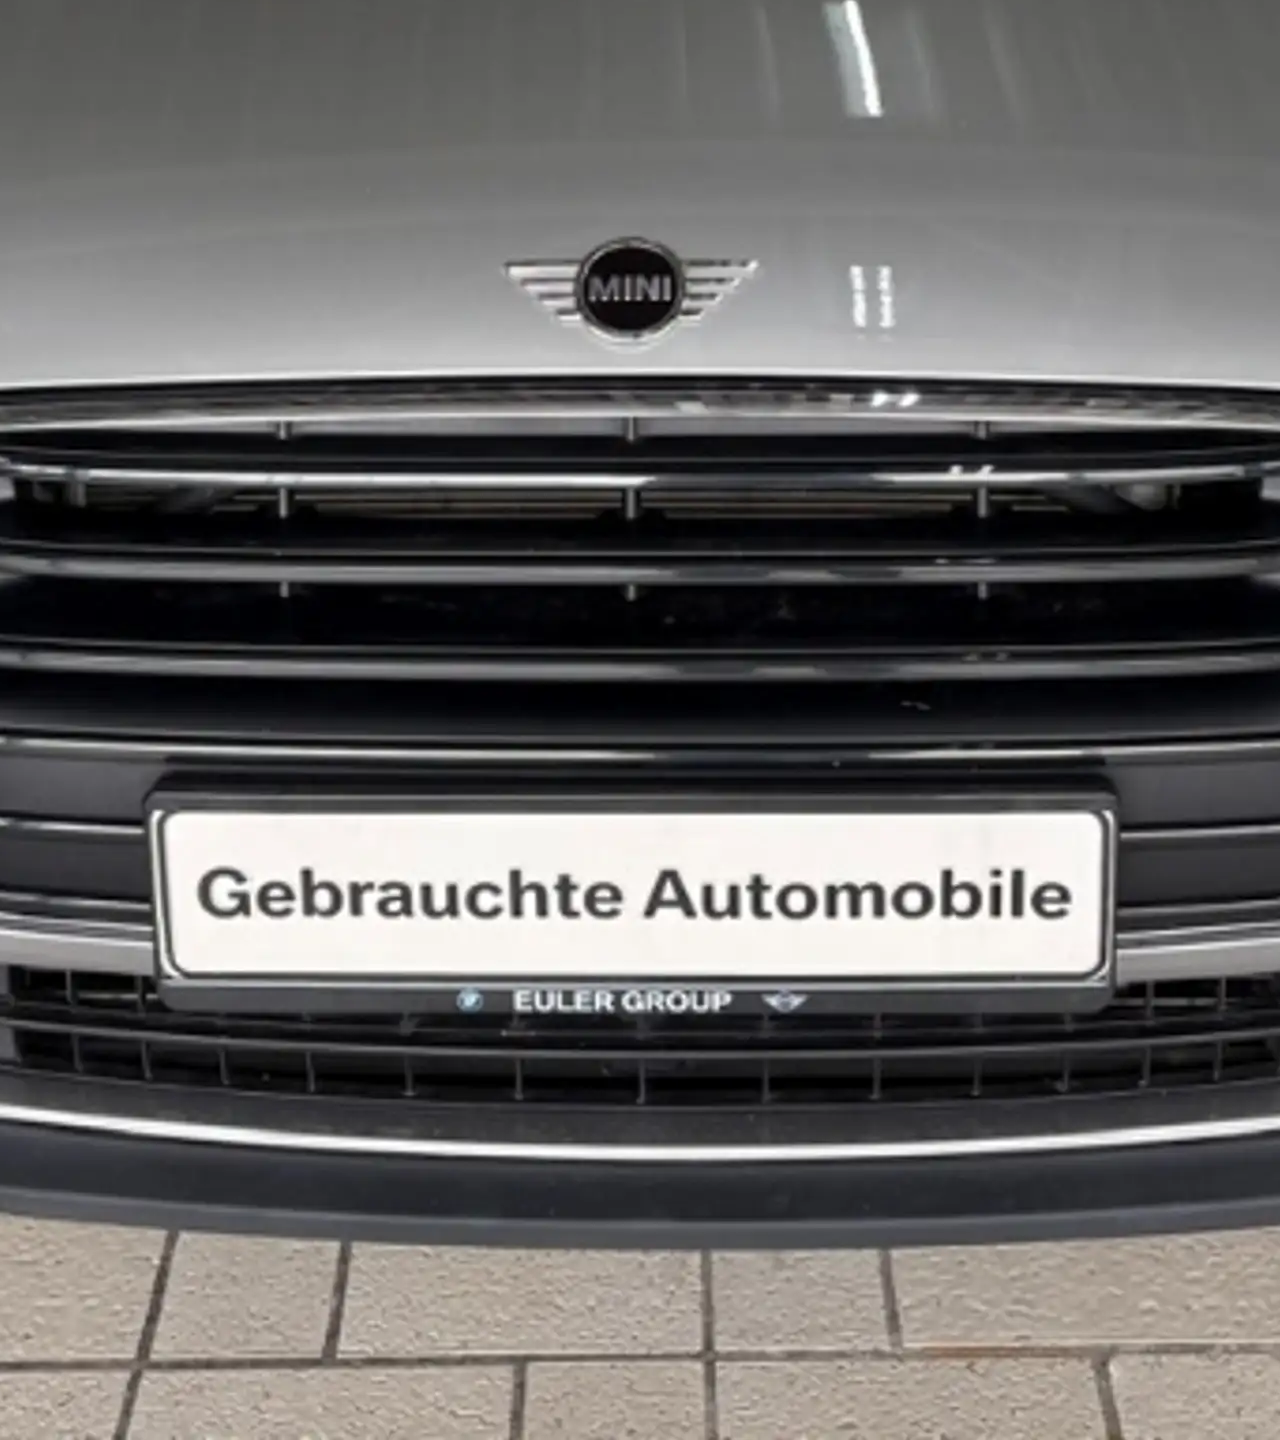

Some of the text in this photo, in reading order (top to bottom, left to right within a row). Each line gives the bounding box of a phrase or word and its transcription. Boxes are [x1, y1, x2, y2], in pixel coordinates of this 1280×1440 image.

[588, 274, 672, 303] MINI
[196, 866, 1073, 921] Gebrauchte Automobile
[512, 989, 734, 1014] EULER GROUP
